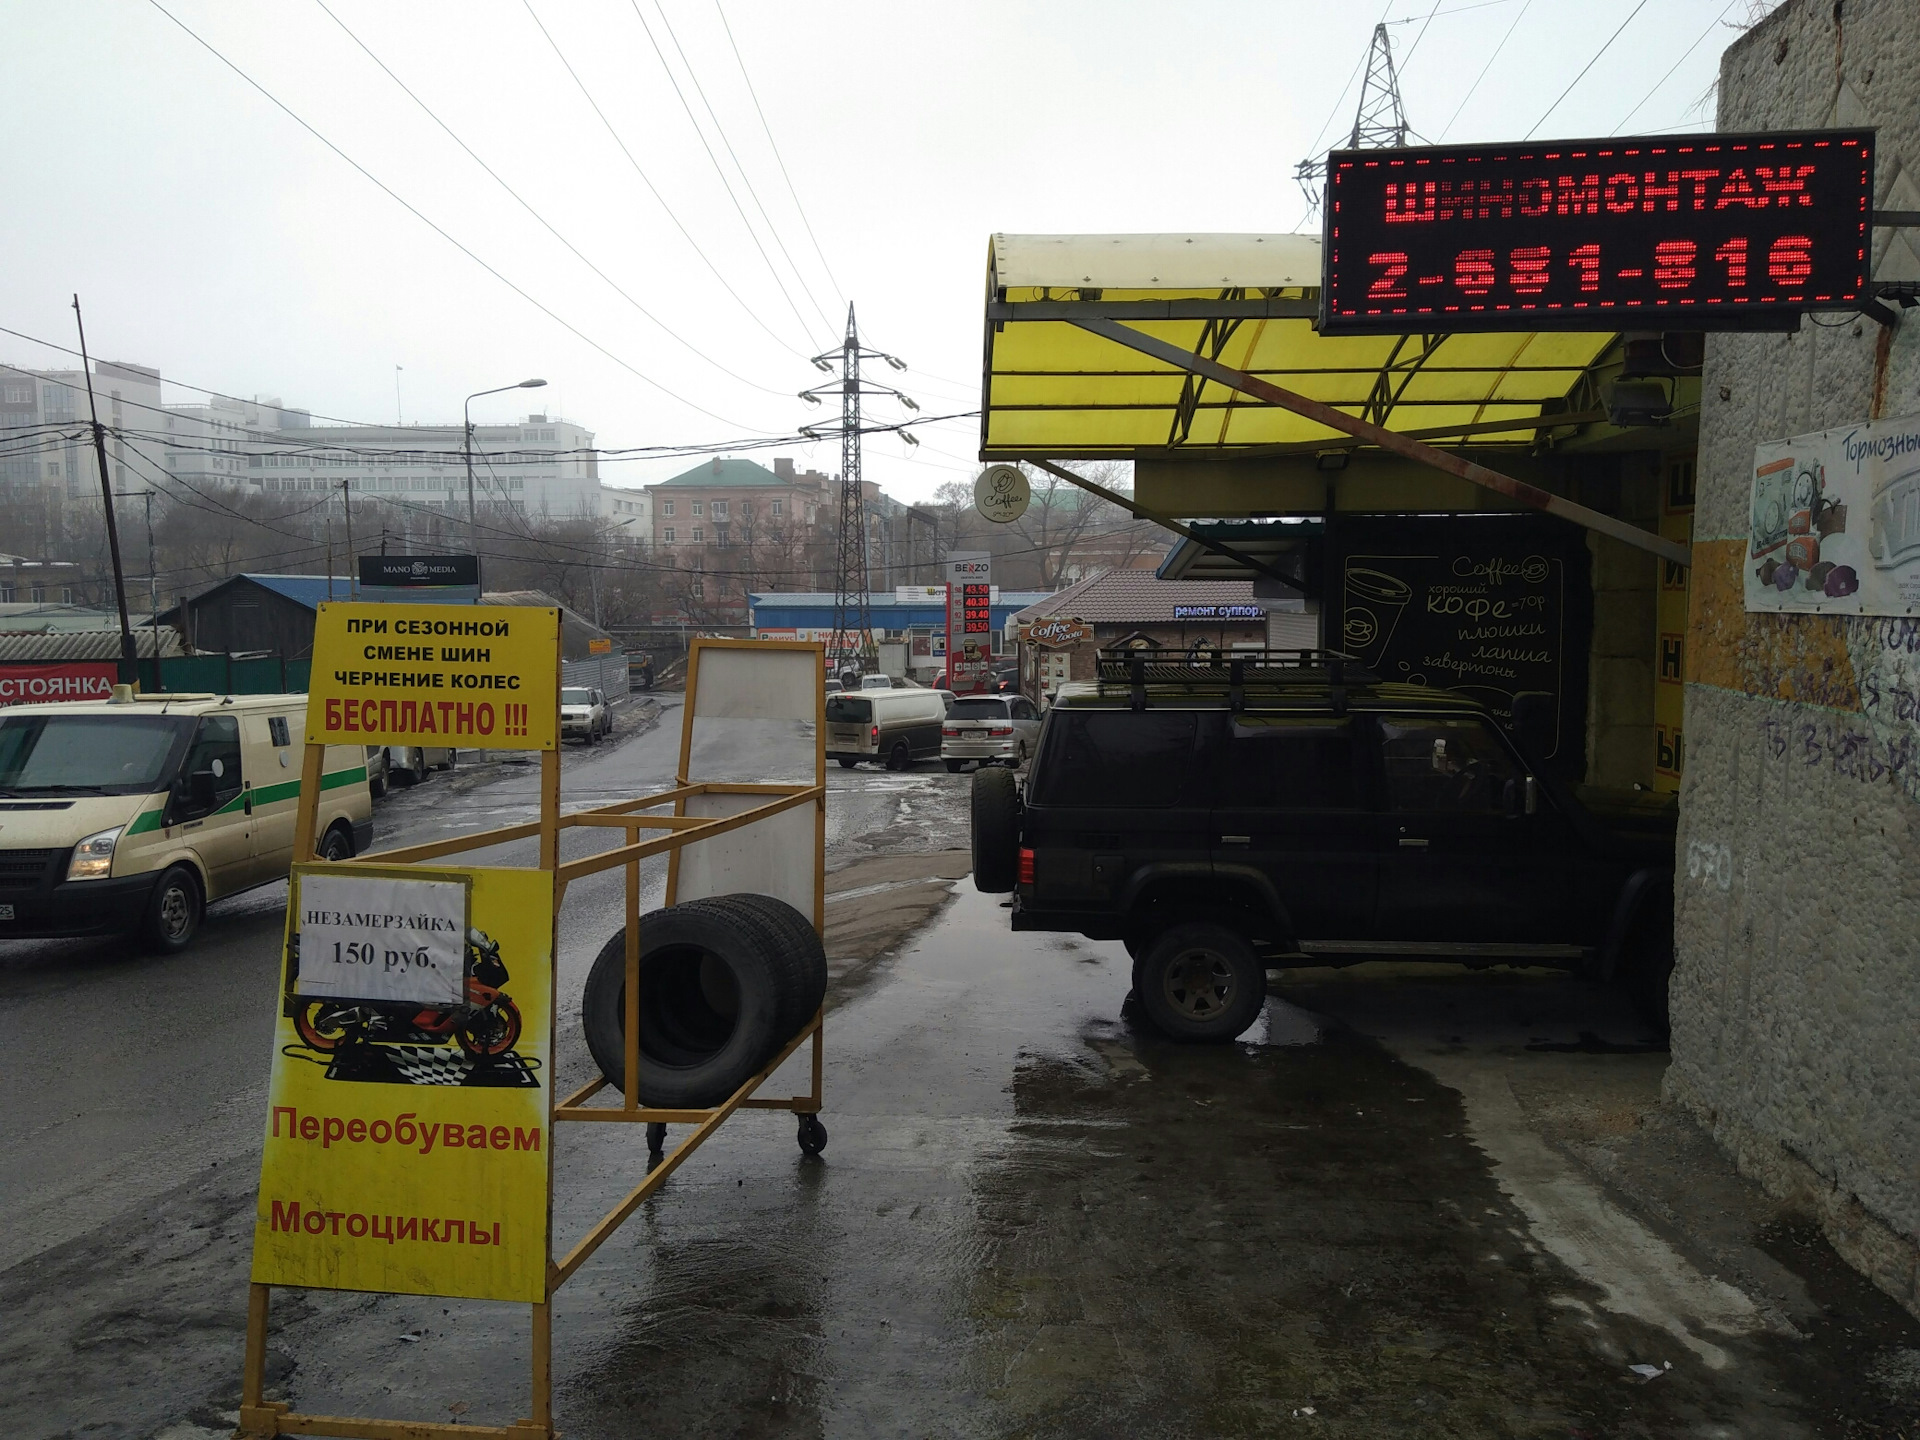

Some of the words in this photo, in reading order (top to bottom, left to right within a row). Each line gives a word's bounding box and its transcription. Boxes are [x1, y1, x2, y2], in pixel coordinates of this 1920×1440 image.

[1385, 165, 1816, 223] ШИНОМОНТАЖ
[1367, 235, 1813, 299] 2-681-816
[383, 566, 411, 574] MANO
[954, 563, 989, 574] BENZO
[1453, 556, 1523, 585] Coffee
[965, 585, 989, 594] 43.50
[1428, 583, 1489, 599] хороший
[965, 598, 989, 607] 40.30
[965, 610, 989, 619] 39.40
[1175, 606, 1217, 618] ремонт
[347, 619, 388, 633] ПРИ
[394, 619, 509, 637] СЕЗОННОЙ
[1030, 622, 1071, 638] Coffee
[1458, 623, 1546, 640] плюшки
[363, 645, 434, 661] СМЕНЕ
[441, 648, 491, 663] ШИН
[1472, 646, 1553, 663] лапша
[1423, 652, 1518, 679] завертоны
[0, 677, 113, 696] СТОЯНКА
[334, 671, 444, 687] ЧЕРНЕНИЕ
[451, 674, 521, 690] КОЛЕС
[325, 698, 495, 736] БЕСПЛАТНО
[504, 704, 528, 736] !!!
[307, 910, 457, 932] НЕЗАМЕРЗАЙКА
[333, 941, 375, 965] 150
[384, 945, 437, 973] руб.
[273, 1106, 541, 1154] Переобуваем
[271, 1200, 500, 1246] Мотоциклы
